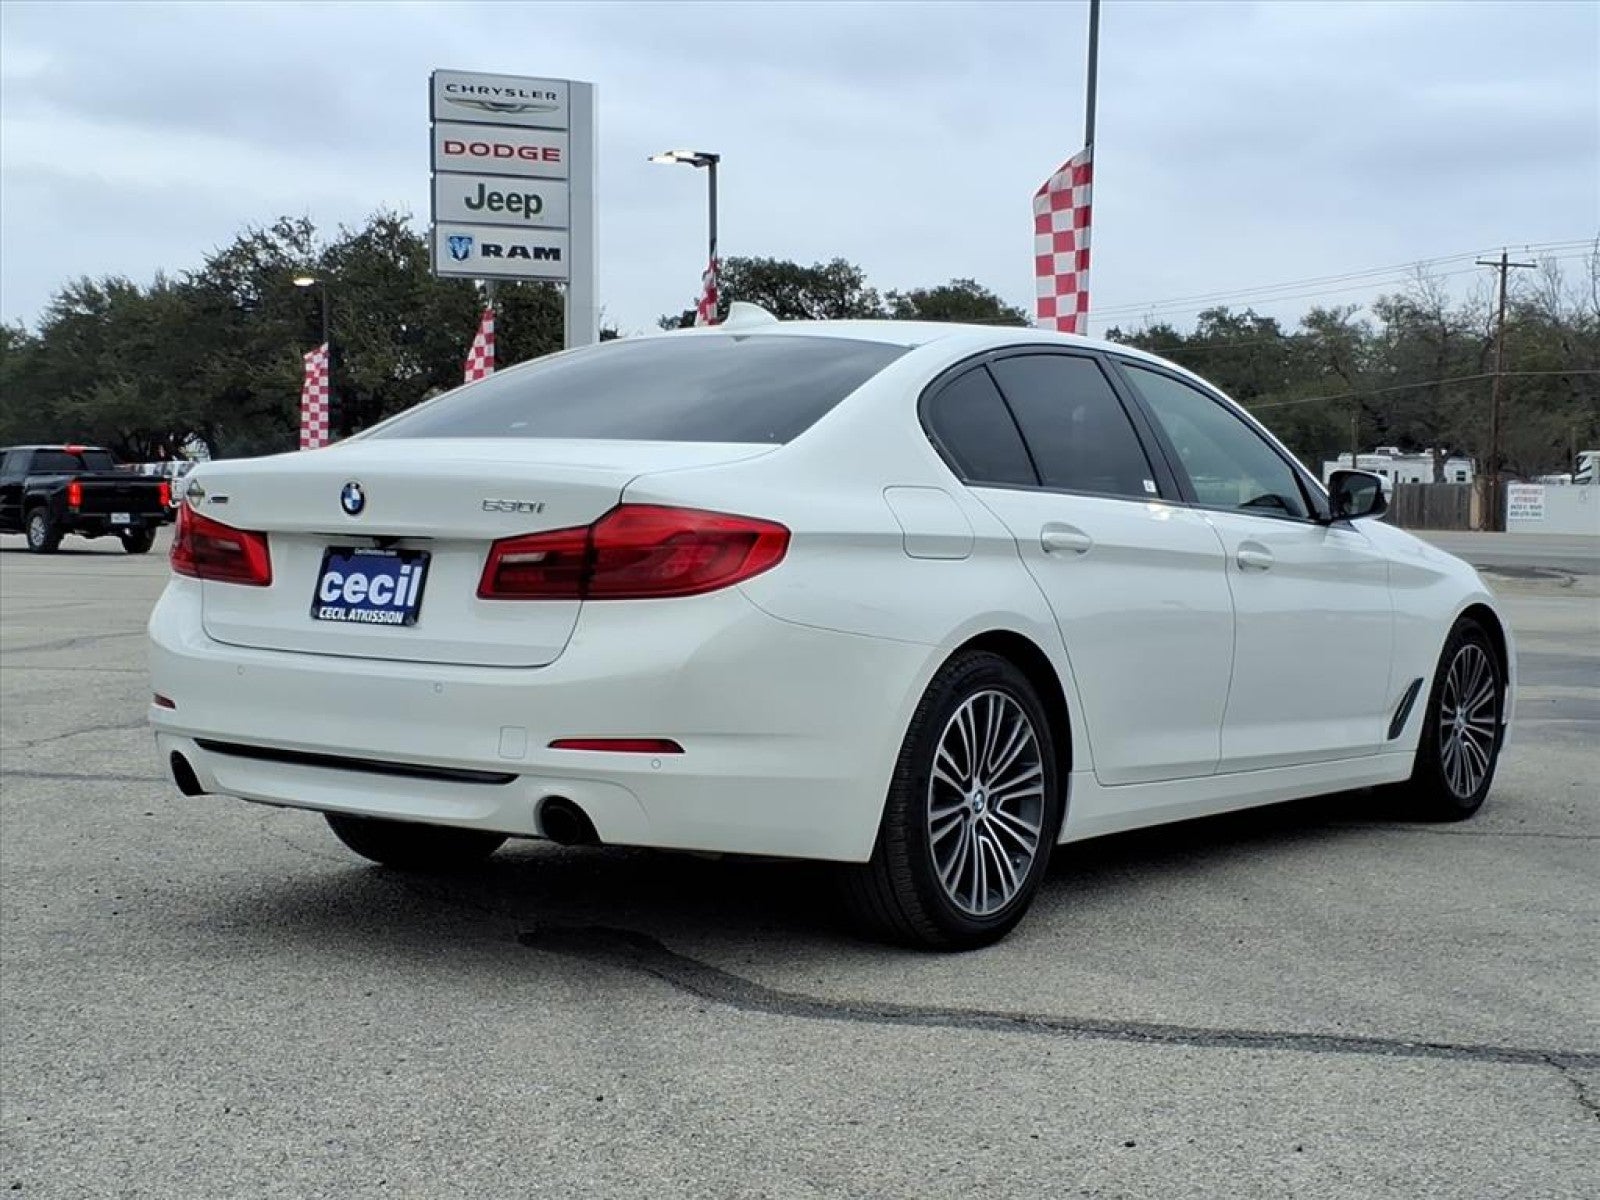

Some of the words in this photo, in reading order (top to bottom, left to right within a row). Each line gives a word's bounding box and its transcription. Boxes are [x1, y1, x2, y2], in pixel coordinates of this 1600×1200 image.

[446, 83, 557, 100] CHRYSLER
[444, 141, 561, 162] DODGE
[464, 183, 543, 219] Jeep
[481, 243, 561, 261] RAM
[320, 565, 423, 606] cecil
[320, 607, 346, 620] CECIL
